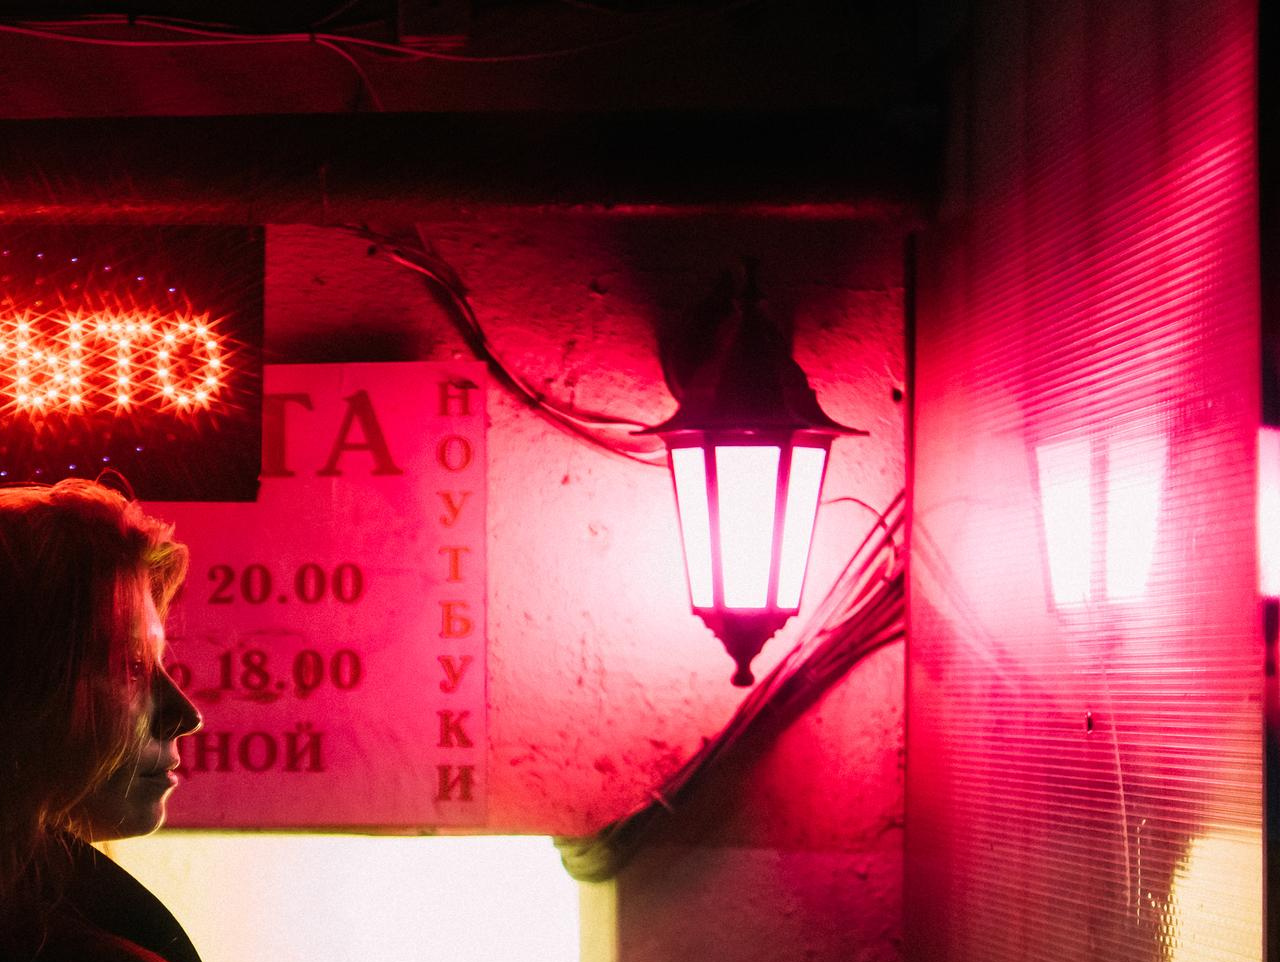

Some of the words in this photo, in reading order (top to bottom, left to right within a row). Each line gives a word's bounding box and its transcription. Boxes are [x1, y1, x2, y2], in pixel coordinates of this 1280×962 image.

[207, 563, 363, 605] 20.00
[435, 380, 475, 802] НОУТБУКИ
[218, 648, 362, 691] 18.00
